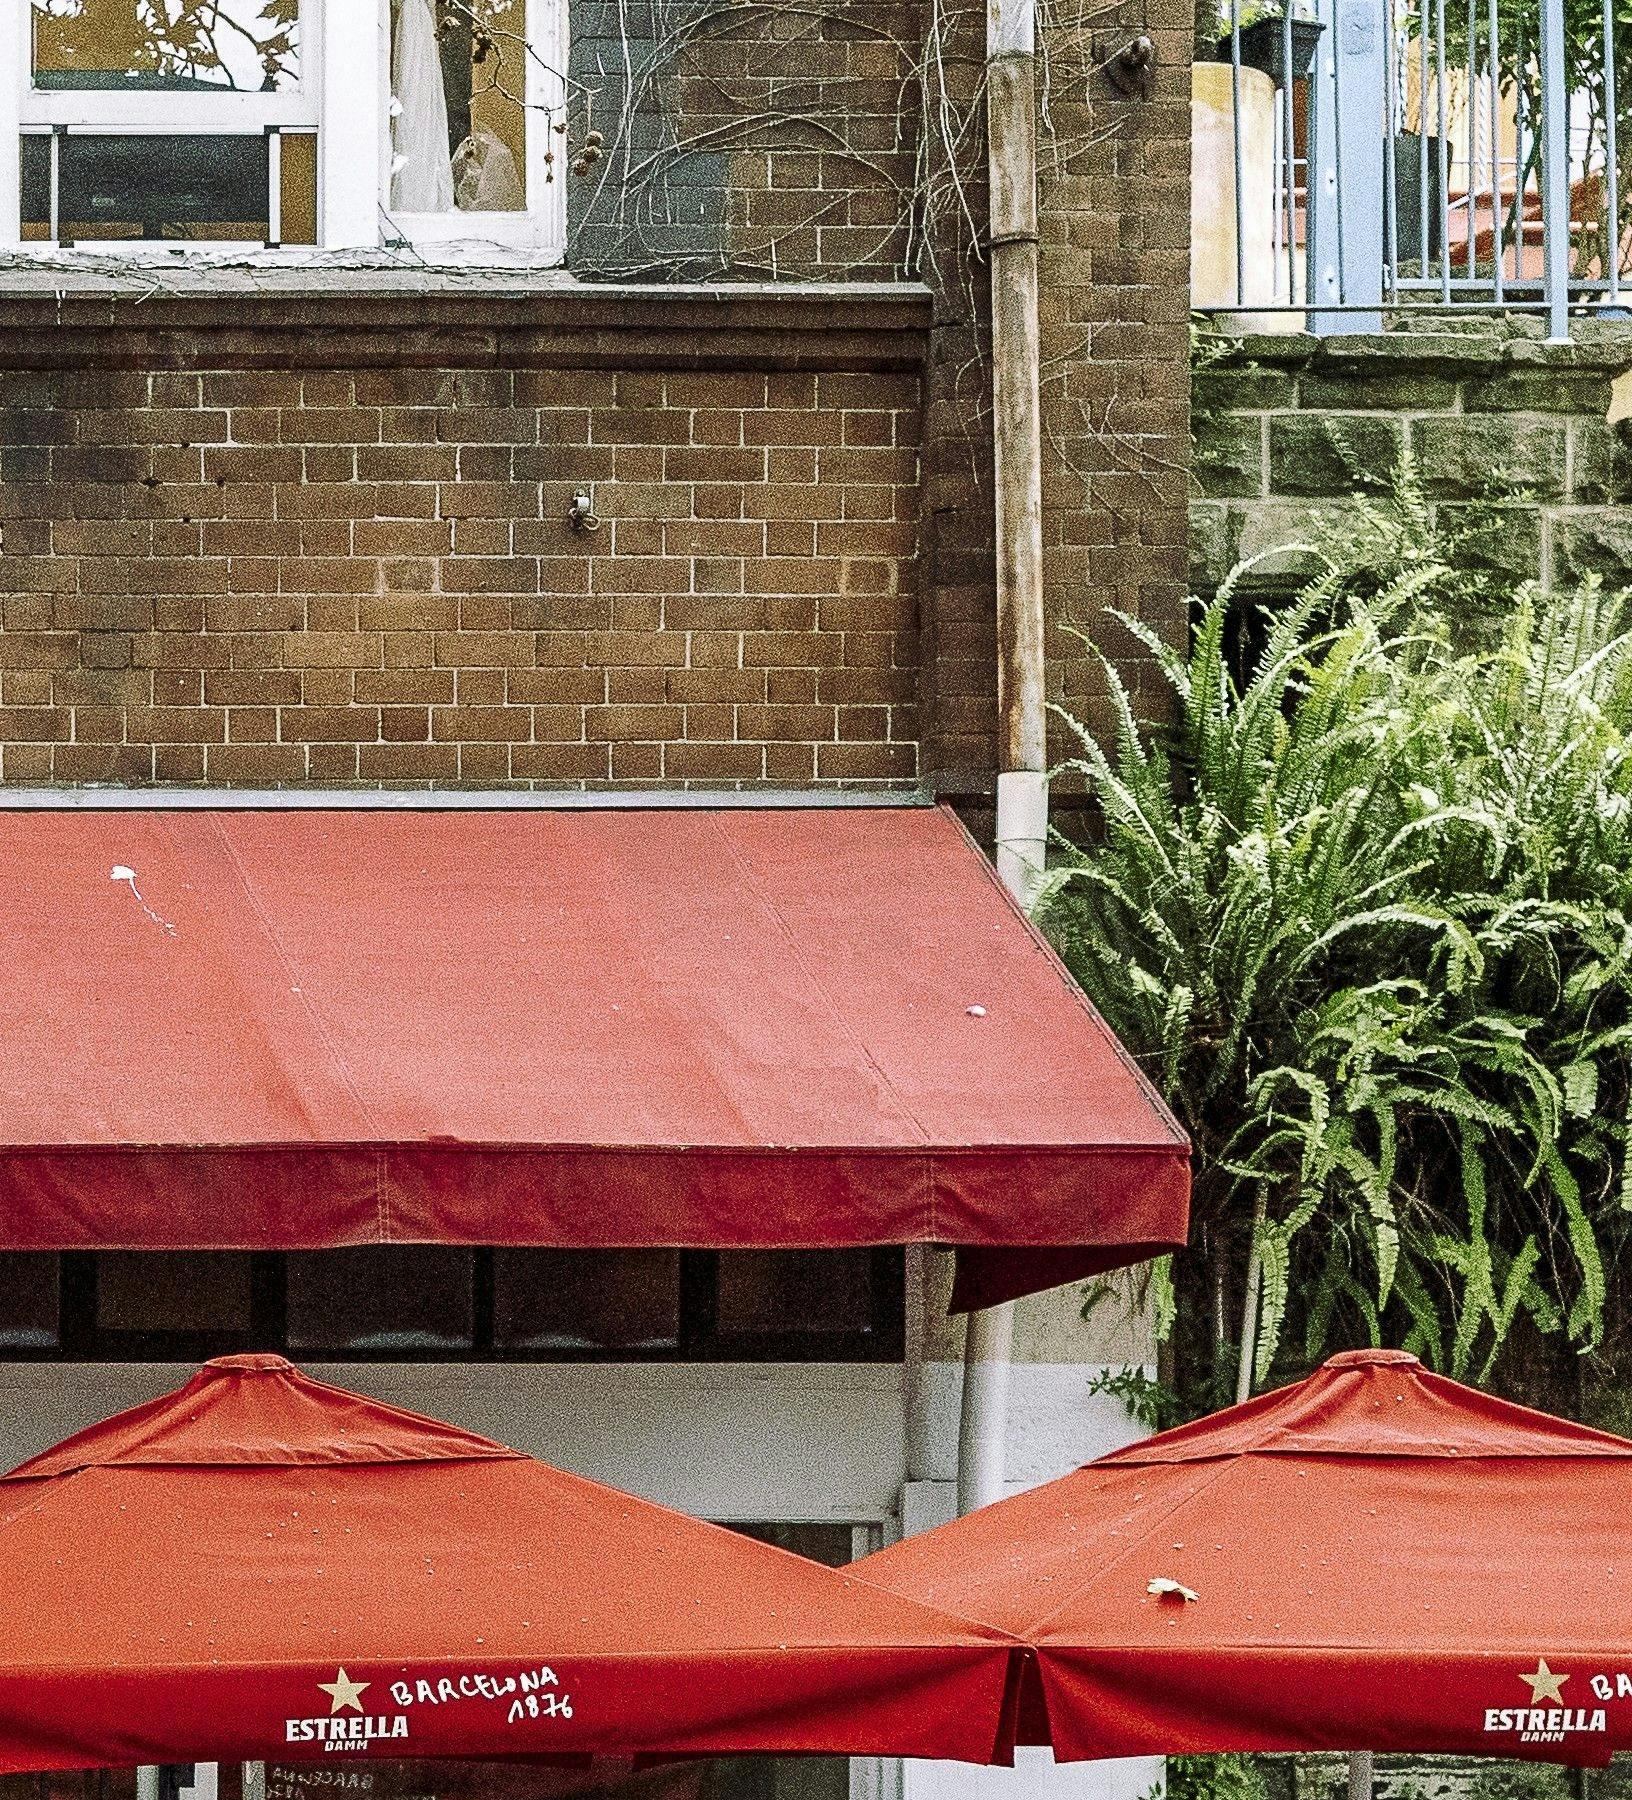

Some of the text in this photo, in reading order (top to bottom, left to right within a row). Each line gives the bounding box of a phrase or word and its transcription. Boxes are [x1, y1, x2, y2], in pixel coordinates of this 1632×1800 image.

[389, 1666, 559, 1707] BARCELONA
[507, 1692, 573, 1724] 1876
[1483, 1708, 1606, 1732] ESTRELLA
[285, 1715, 409, 1743] ESTRELLA
[1520, 1731, 1565, 1743] DAMM
[324, 1739, 368, 1752] DAMM
